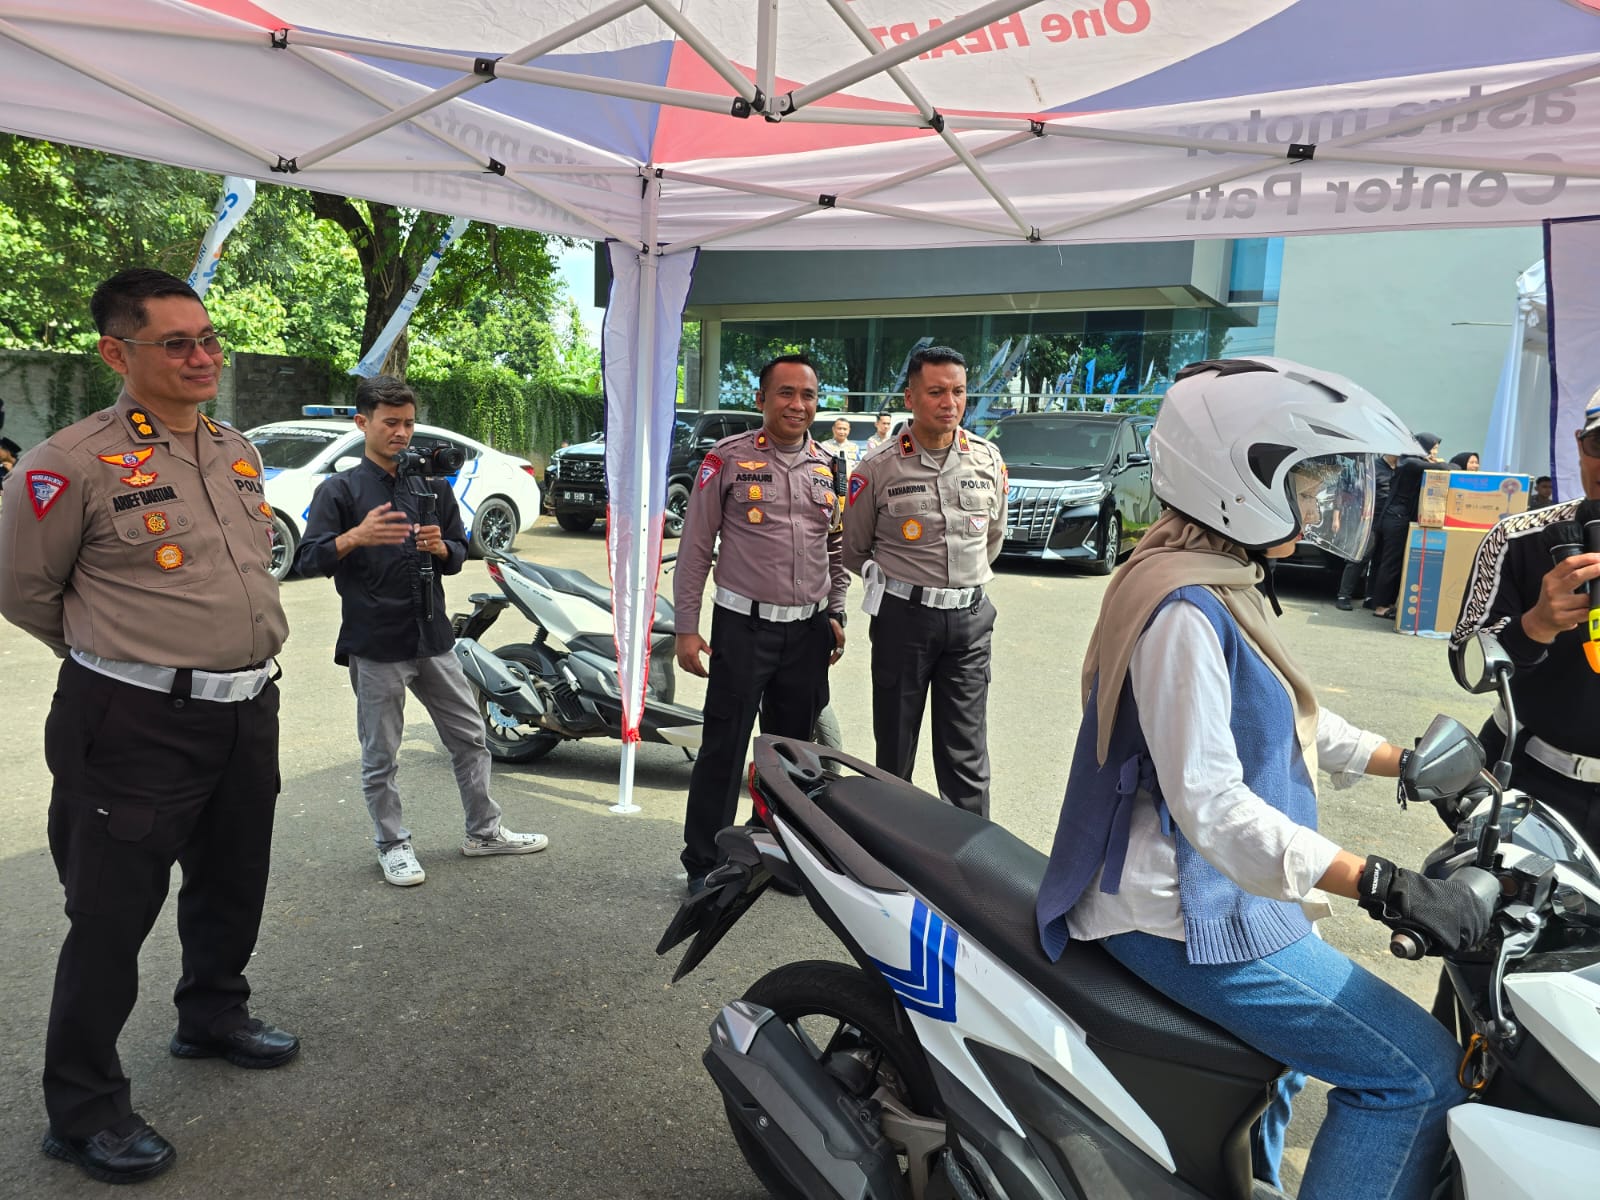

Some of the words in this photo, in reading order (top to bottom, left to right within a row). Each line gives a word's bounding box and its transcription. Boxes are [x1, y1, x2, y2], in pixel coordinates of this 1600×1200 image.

[735, 473, 773, 483] ASFAURI
[960, 479, 991, 490] POLRI
[112, 492, 140, 513] ARIEF
[139, 485, 178, 506] BAHTIAR
